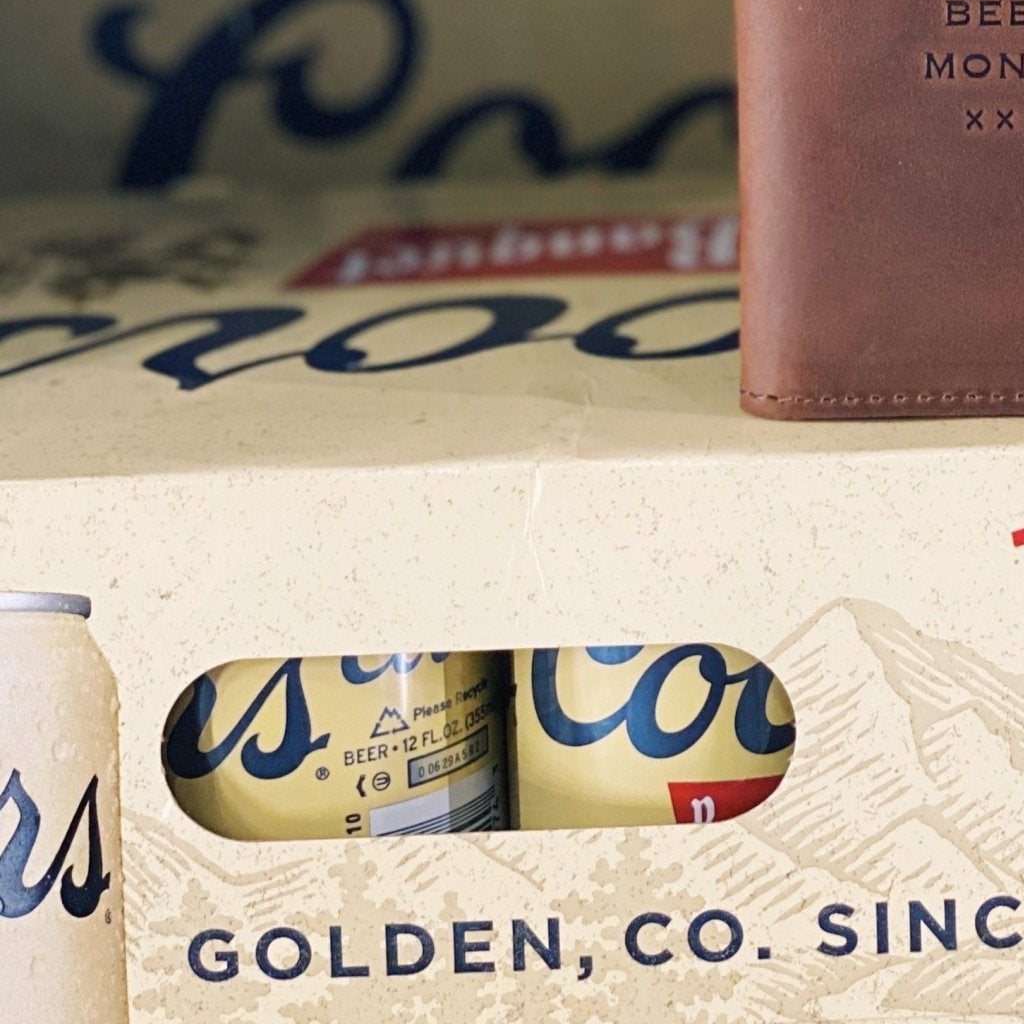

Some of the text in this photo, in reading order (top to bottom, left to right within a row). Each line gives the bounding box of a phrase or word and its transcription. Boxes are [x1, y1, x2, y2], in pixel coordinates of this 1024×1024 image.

[413, 699, 452, 722] Please
[343, 743, 388, 767] BEER
[403, 735, 418, 754] 12
[187, 917, 594, 981] GOLDEN,
[624, 908, 771, 966] CO.
